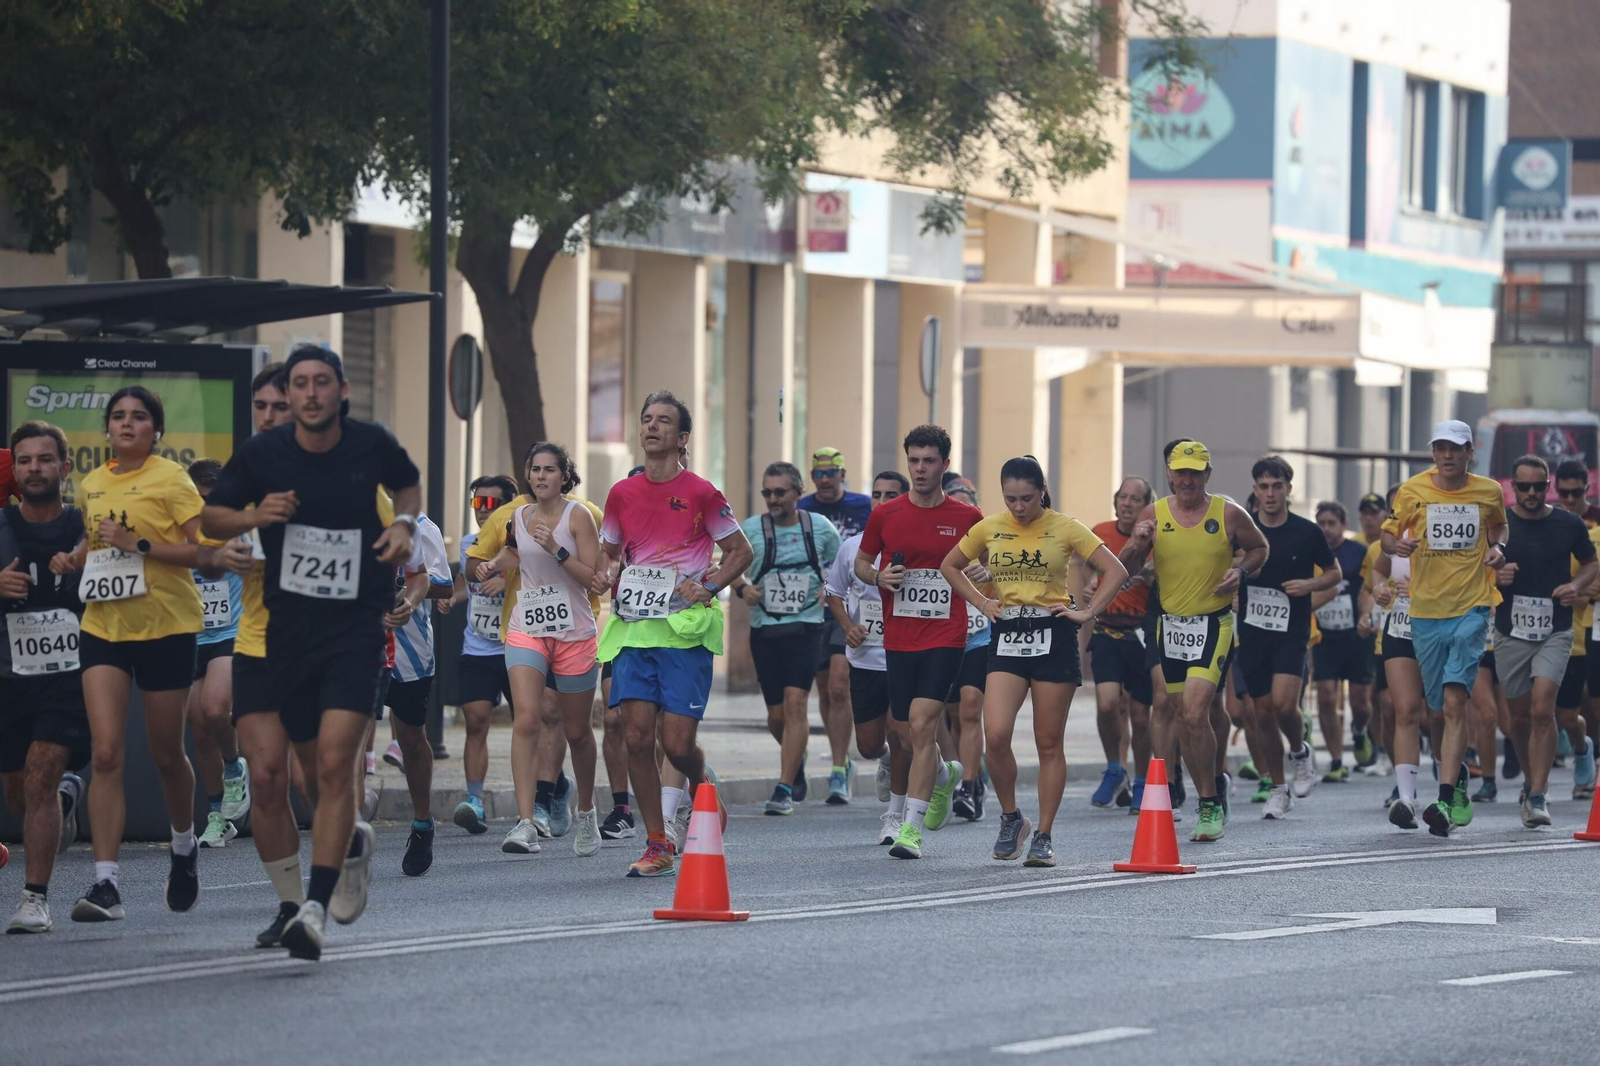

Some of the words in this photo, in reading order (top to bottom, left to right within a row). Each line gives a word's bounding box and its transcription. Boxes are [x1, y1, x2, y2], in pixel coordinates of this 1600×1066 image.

[1014, 304, 1121, 329] Alhambra
[97, 359, 120, 369] Clear
[121, 359, 157, 369] Channel
[26, 385, 112, 413] Sprin
[1432, 523, 1476, 539] 5840
[290, 553, 351, 582] 7241
[990, 552, 1013, 567] 45
[629, 568, 645, 578] 45
[85, 574, 139, 600] 2607
[622, 588, 667, 607] 2184
[769, 589, 806, 603] 7346
[899, 587, 949, 604] 10203
[203, 599, 229, 615] 275
[525, 603, 568, 626] 5886
[1250, 602, 1288, 619] 10272
[474, 613, 502, 629] 774
[865, 619, 884, 635] 73
[967, 615, 985, 629] 56
[1513, 612, 1551, 628] 11312
[14, 633, 79, 656] 10640
[1166, 630, 1204, 647] 10298
